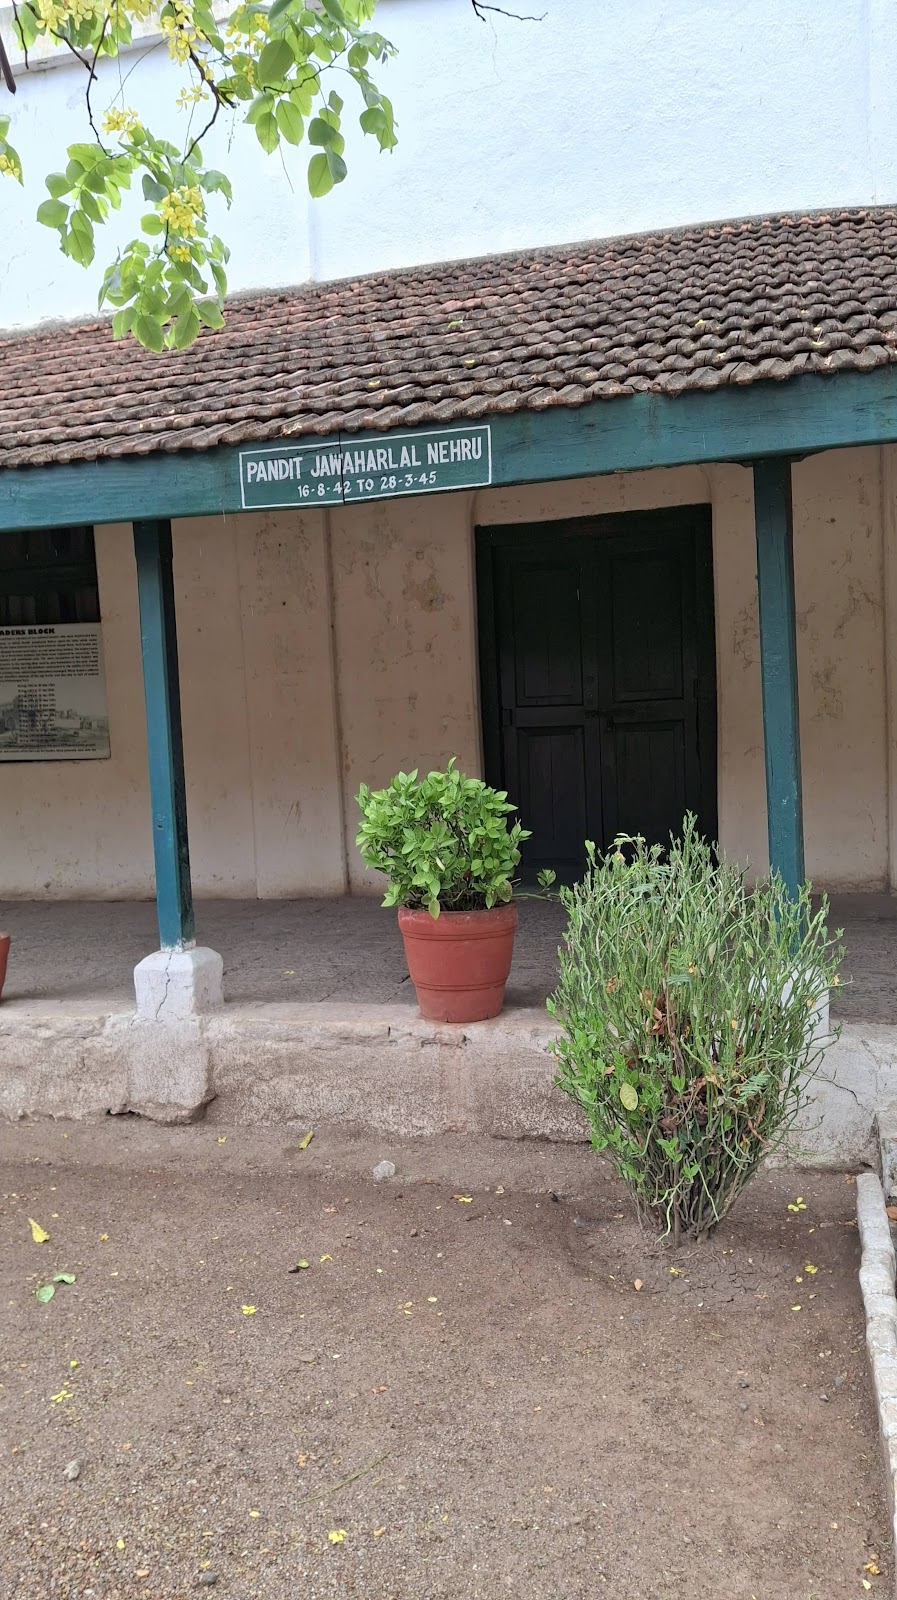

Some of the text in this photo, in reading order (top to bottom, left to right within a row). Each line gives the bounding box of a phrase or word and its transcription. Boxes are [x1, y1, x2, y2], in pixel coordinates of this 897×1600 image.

[247, 436, 482, 483] PANDIT JAWAHARLAL NEHRU
[297, 471, 437, 498] 16-8-42 TO 28-3-45
[28, 627, 55, 635] BLOCK
